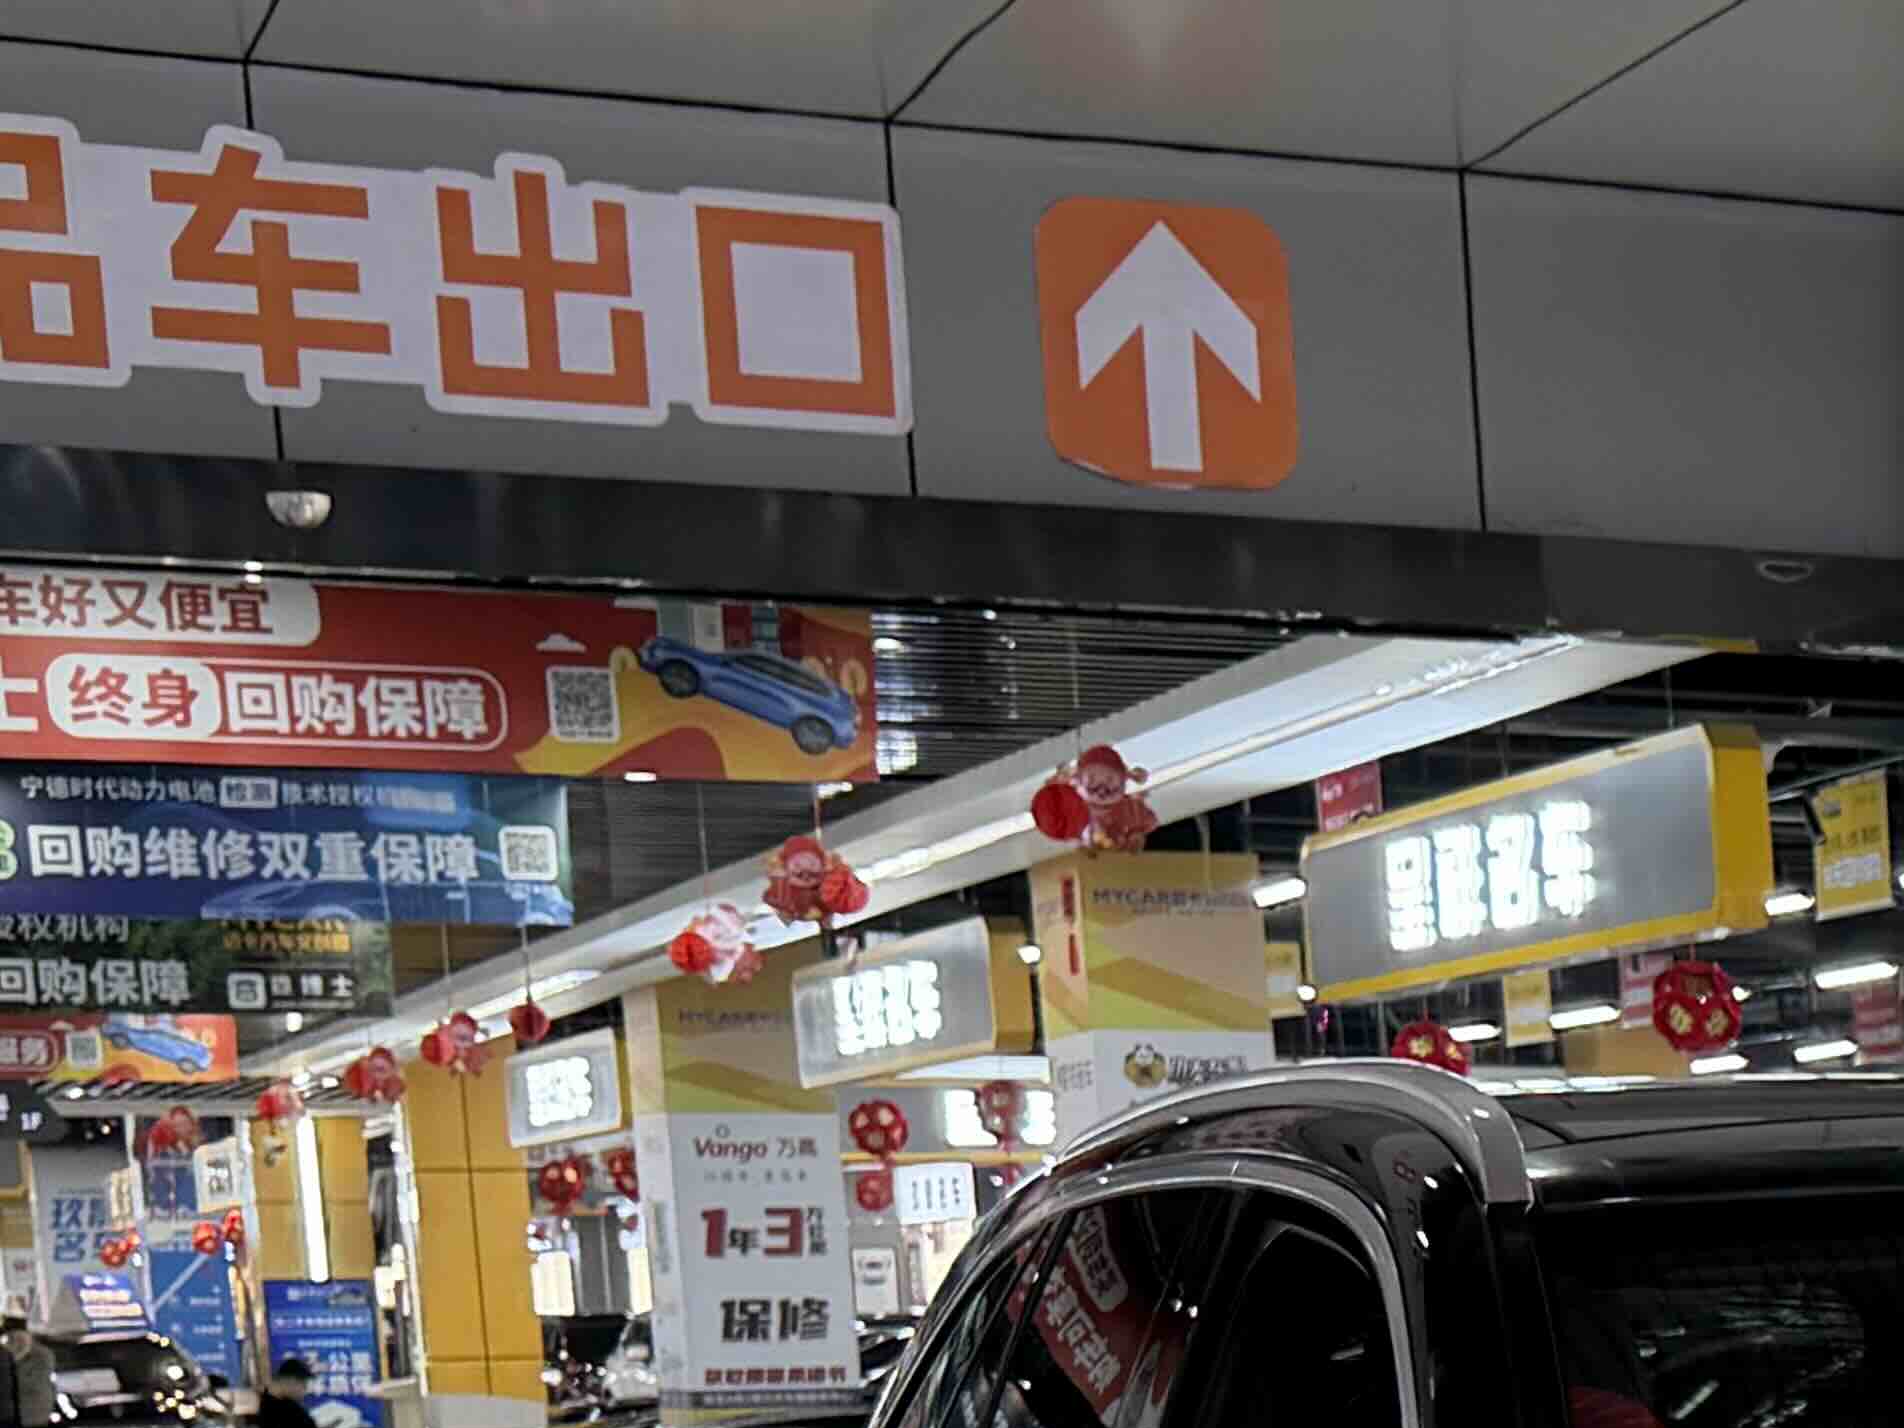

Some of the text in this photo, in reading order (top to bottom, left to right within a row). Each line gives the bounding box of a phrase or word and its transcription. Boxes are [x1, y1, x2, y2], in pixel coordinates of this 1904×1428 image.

[68, 664, 198, 729] 终身
[225, 671, 490, 741] 回购保障
[28, 824, 479, 883] 回购维修双重保障
[0, 958, 190, 1006] 回购保障
[720, 1297, 828, 1343] 保修
